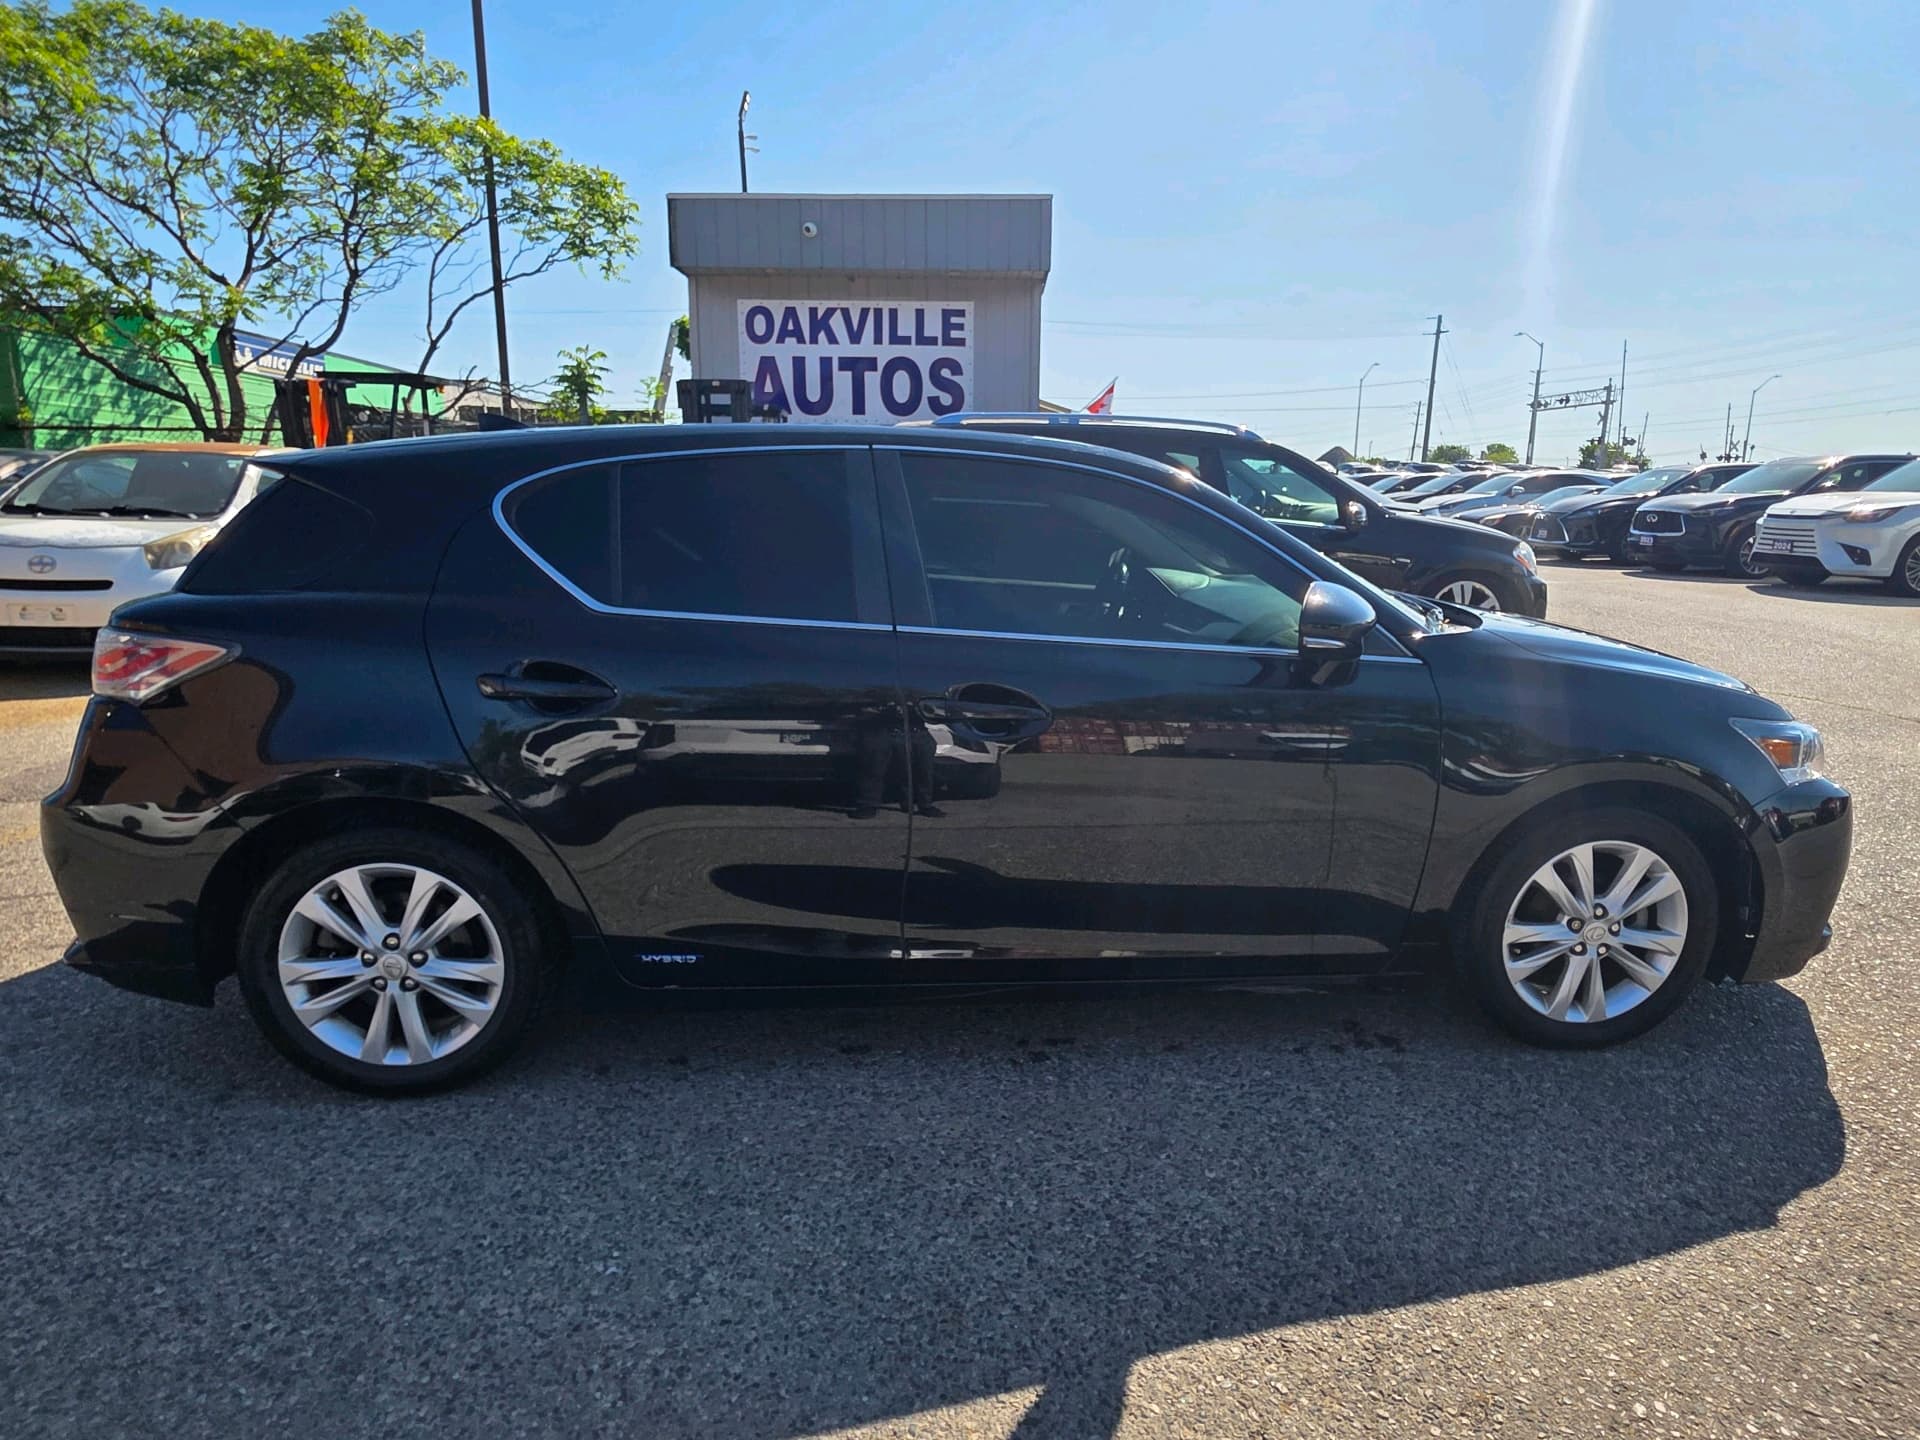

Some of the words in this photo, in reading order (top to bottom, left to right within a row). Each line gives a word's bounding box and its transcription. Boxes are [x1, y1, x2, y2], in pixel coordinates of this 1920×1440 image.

[745, 305, 966, 347] OAKVILLE
[753, 356, 965, 417] AUTOS
[641, 955, 697, 963] HYBRID
